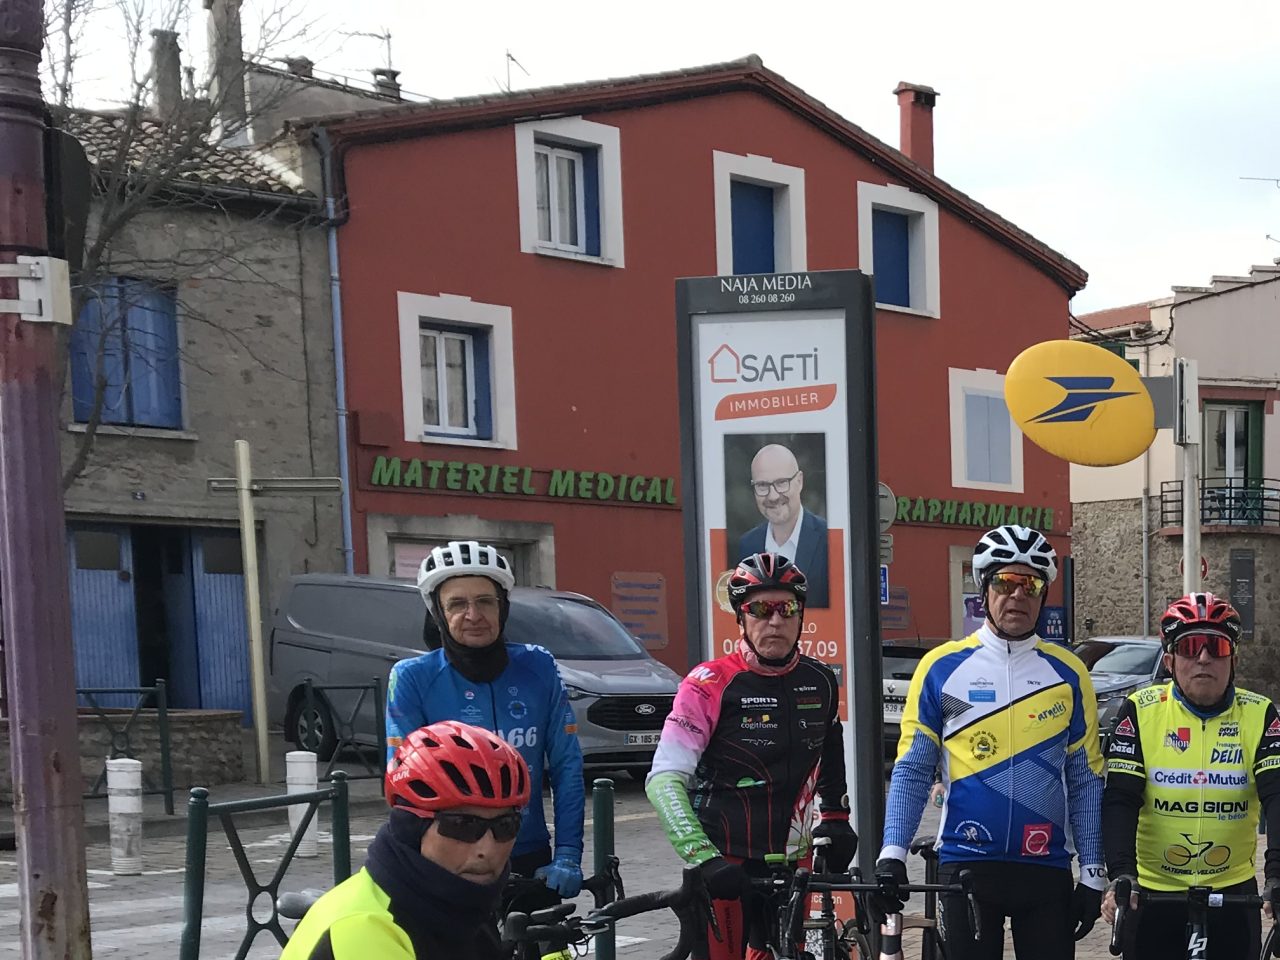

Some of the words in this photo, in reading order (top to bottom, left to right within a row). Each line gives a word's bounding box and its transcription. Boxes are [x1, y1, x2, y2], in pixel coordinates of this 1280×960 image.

[720, 277, 759, 293] NAJA
[762, 275, 812, 291] MEDIA
[738, 295, 749, 304] 08
[750, 294, 767, 304] 260
[779, 293, 795, 302] 260
[729, 392, 819, 412] IMMOBILIER
[371, 455, 536, 494] MATERIEL
[549, 469, 677, 503] MEDICAL
[1164, 735, 1190, 750] Dijon
[1154, 771, 1193, 784] Crédit
[1208, 773, 1248, 785] Mutuel
[1087, 867, 1107, 878] VC
